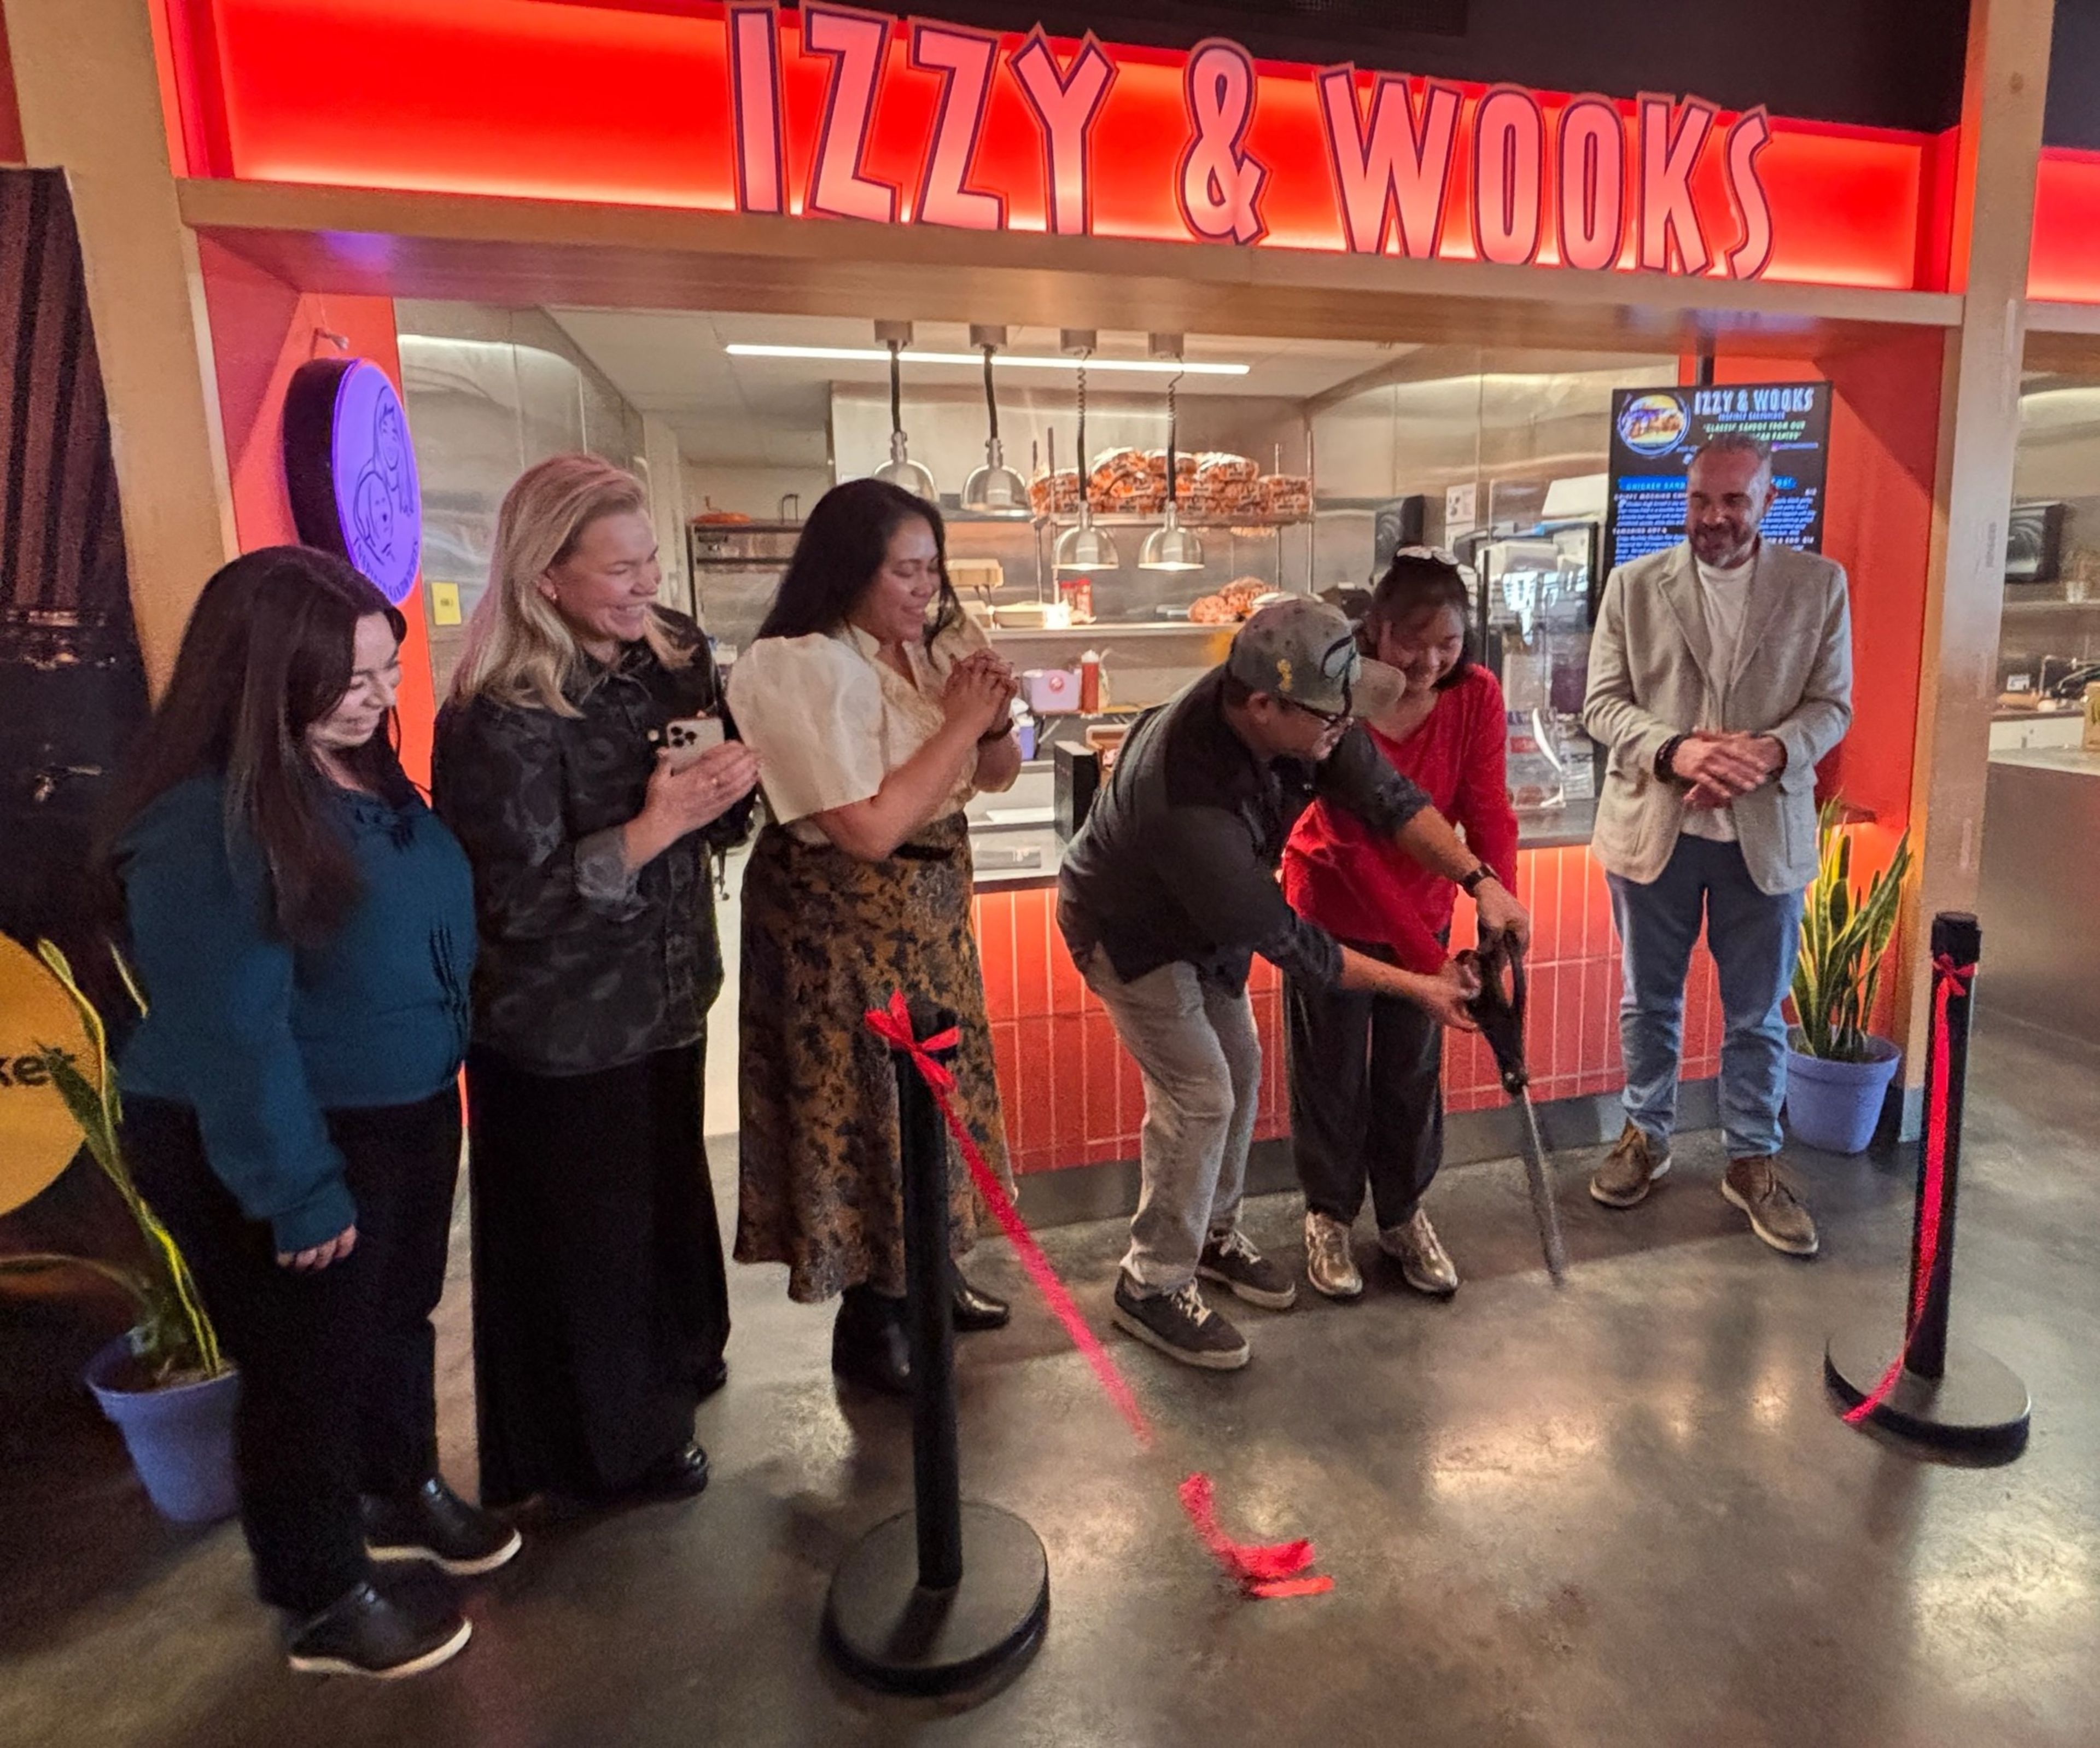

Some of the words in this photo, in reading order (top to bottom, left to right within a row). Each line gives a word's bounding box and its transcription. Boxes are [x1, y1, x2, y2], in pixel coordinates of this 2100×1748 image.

[726, 0, 1119, 238] IZZY
[1175, 37, 1271, 246] &
[1315, 61, 1774, 280] WOOKS
[1694, 390, 1734, 415] IZZY
[1737, 389, 1748, 412] &
[1753, 387, 1814, 412] WOOKS
